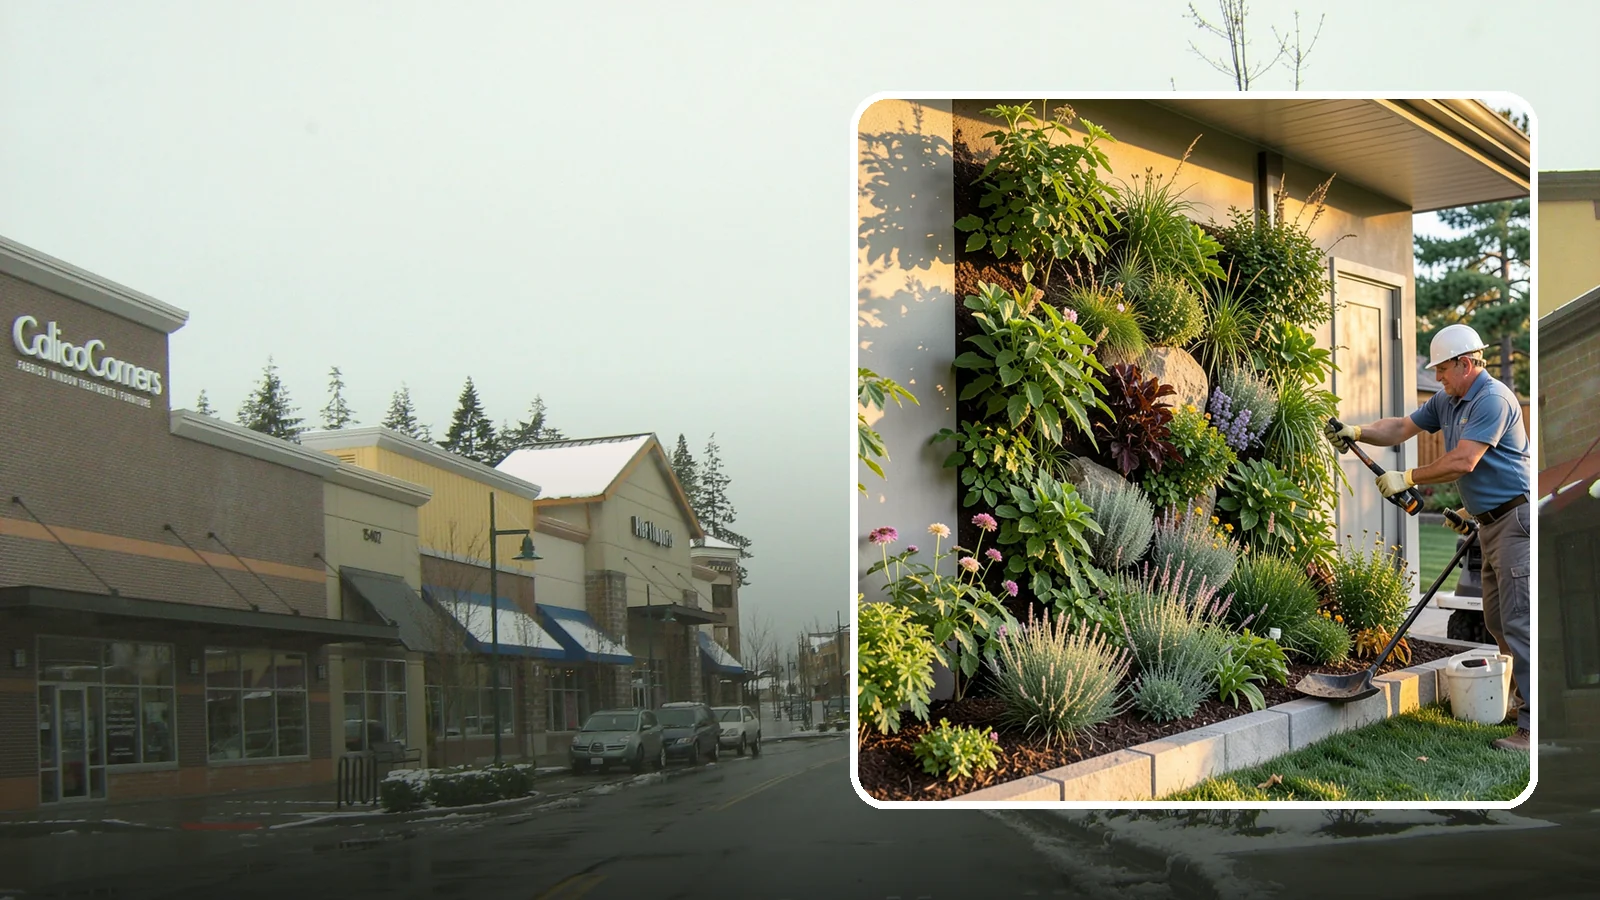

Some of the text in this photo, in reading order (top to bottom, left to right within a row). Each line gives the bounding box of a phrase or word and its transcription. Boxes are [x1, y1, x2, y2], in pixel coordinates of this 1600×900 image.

[17, 360, 151, 408] FABRICS WINDOW TREATMENTS FURNITURE
